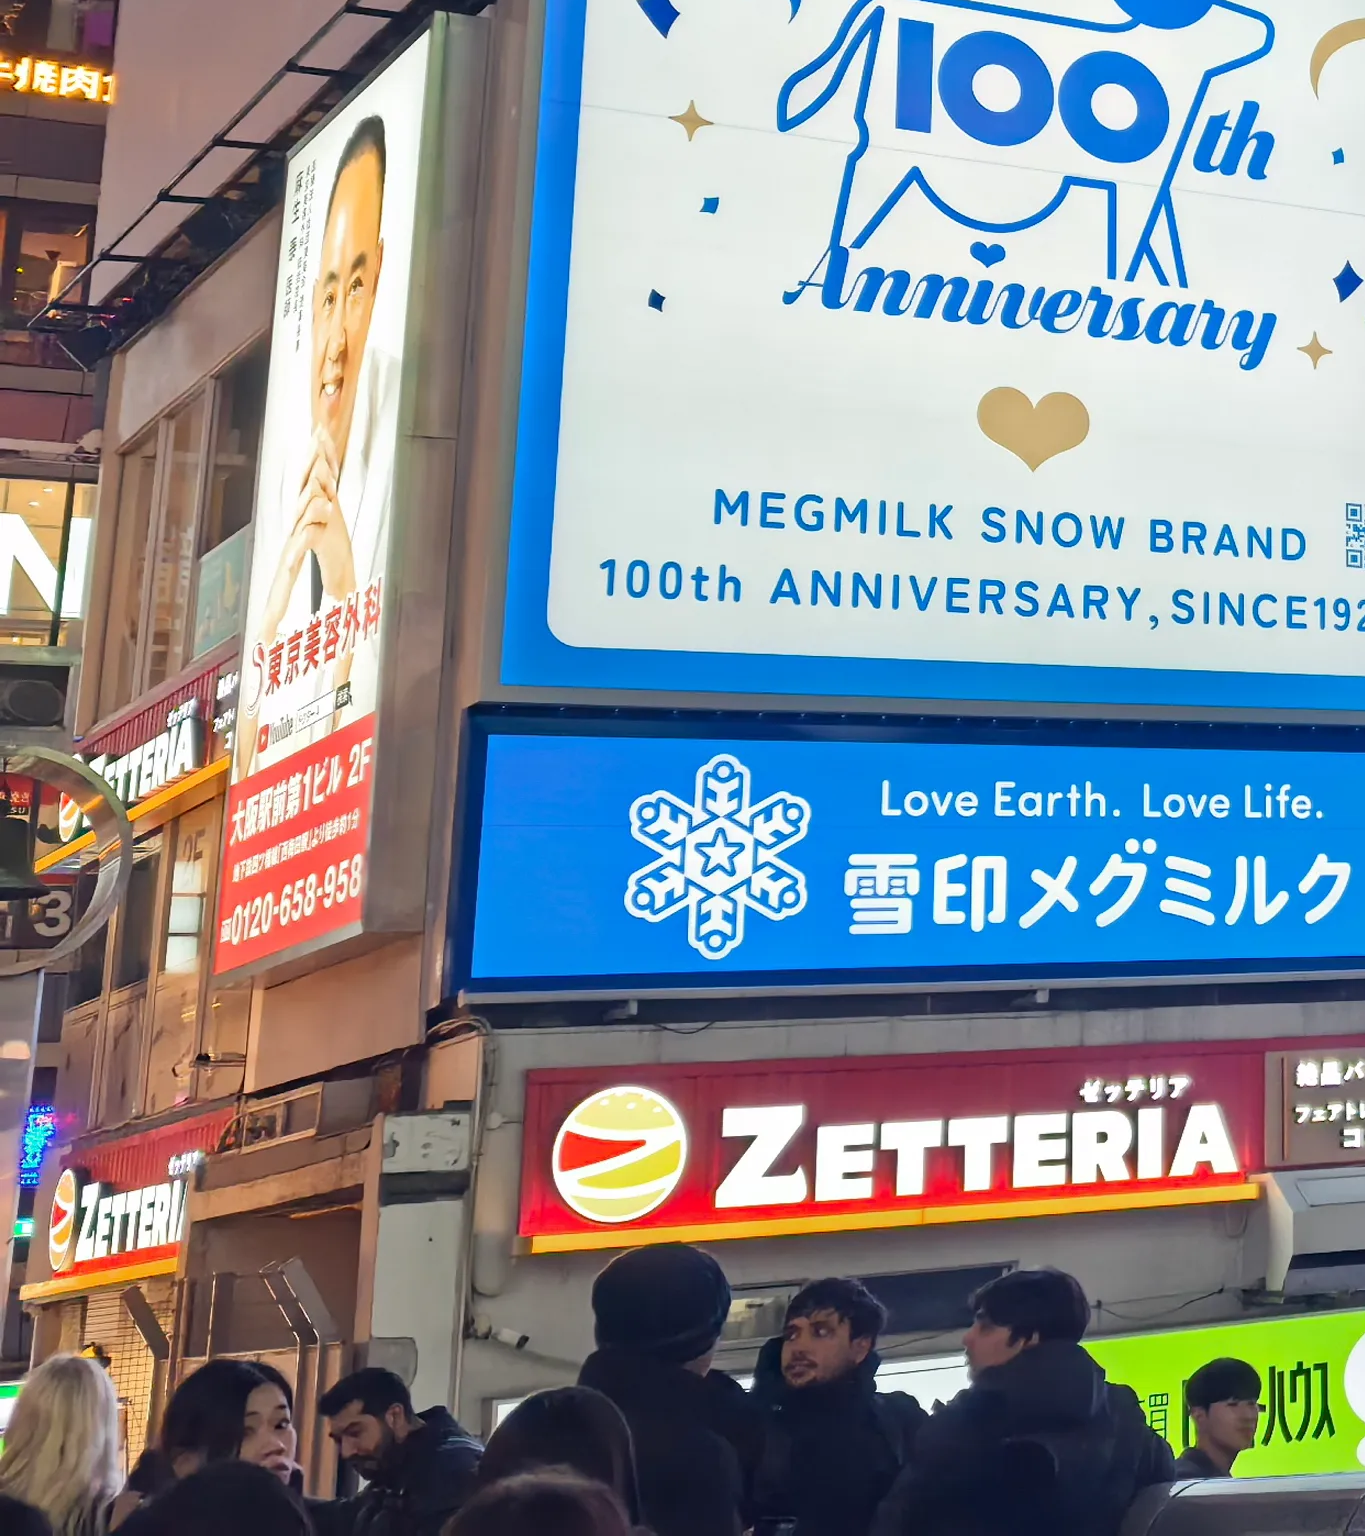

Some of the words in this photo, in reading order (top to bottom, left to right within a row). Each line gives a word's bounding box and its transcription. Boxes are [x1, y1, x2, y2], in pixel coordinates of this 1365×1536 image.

[782, 243, 1278, 372] Anniversary
[712, 488, 955, 541] MEGMILK
[980, 506, 1126, 551] SNOW
[1149, 518, 1308, 562] BRAND
[598, 557, 743, 604] 100th
[265, 576, 382, 697] 東京美容外科
[346, 736, 374, 789] 2F
[880, 779, 979, 819] Love
[993, 780, 1121, 818] Earth.
[1142, 782, 1233, 819] Love
[1243, 783, 1325, 820] Life.
[230, 852, 363, 946] 0120-658-958
[845, 839, 1353, 936] 雪印メグミルク
[1079, 1075, 1191, 1104] ゼッテリア
[713, 1102, 1240, 1210] ZETTERIA
